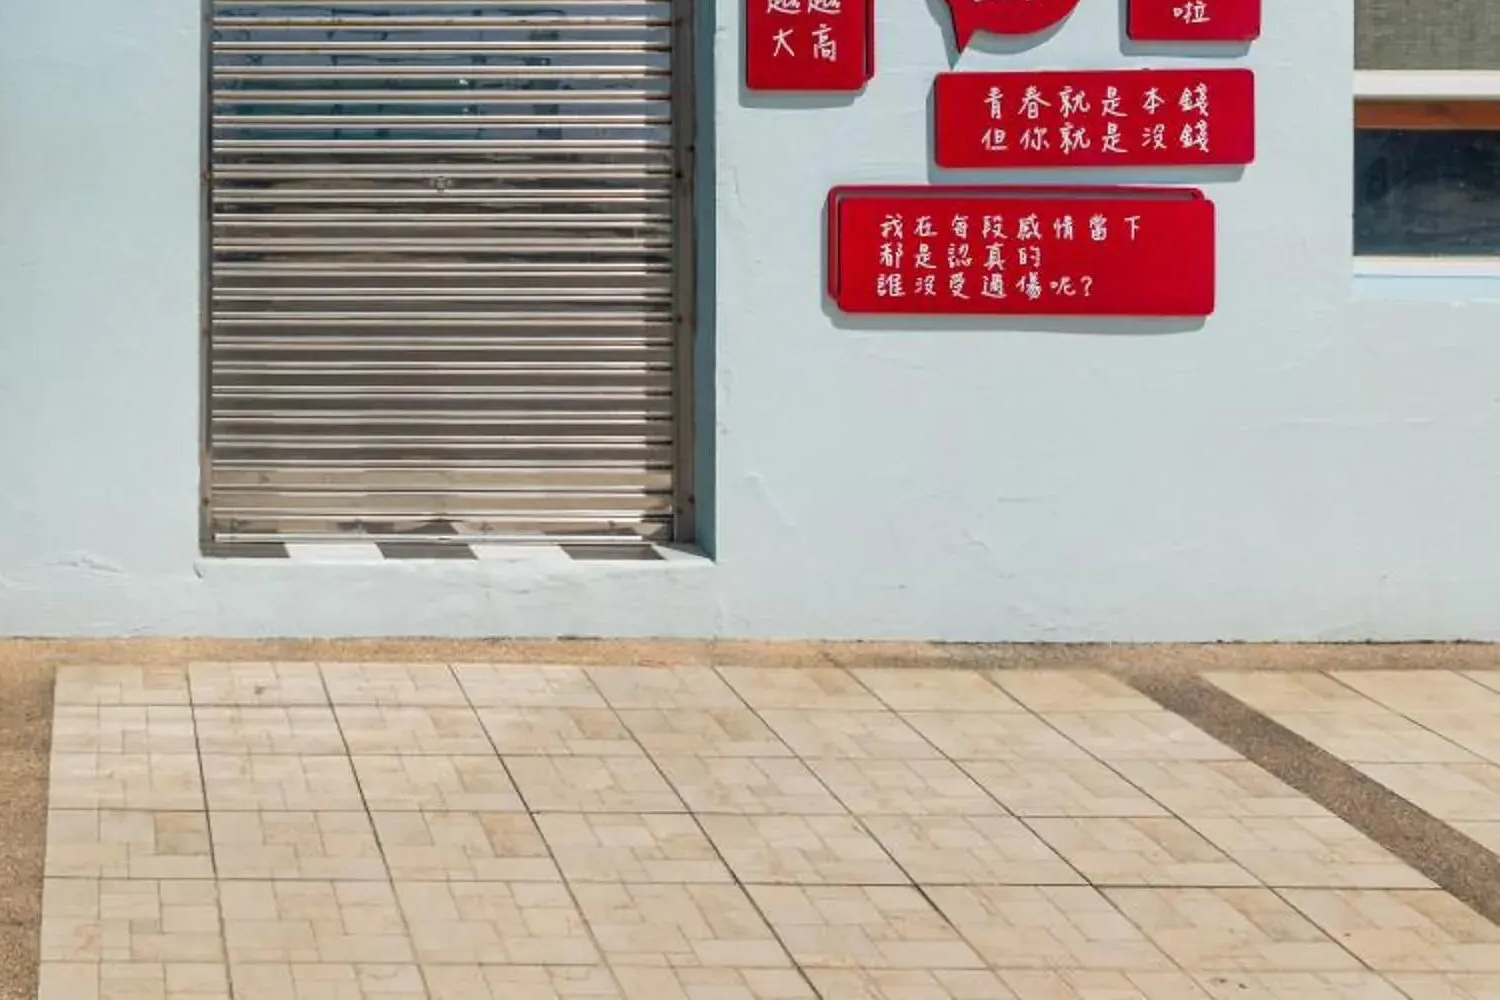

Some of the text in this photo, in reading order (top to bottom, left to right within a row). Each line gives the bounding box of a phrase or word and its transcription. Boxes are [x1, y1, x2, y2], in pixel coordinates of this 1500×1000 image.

[984, 82, 1209, 120] 青春就是本錢
[981, 116, 1209, 155] 但你就是沒錢
[880, 213, 1141, 241] 我在每段感情當下
[880, 241, 1041, 271] 都是認真的
[877, 271, 1093, 300] 誰沒受過傷呢?
